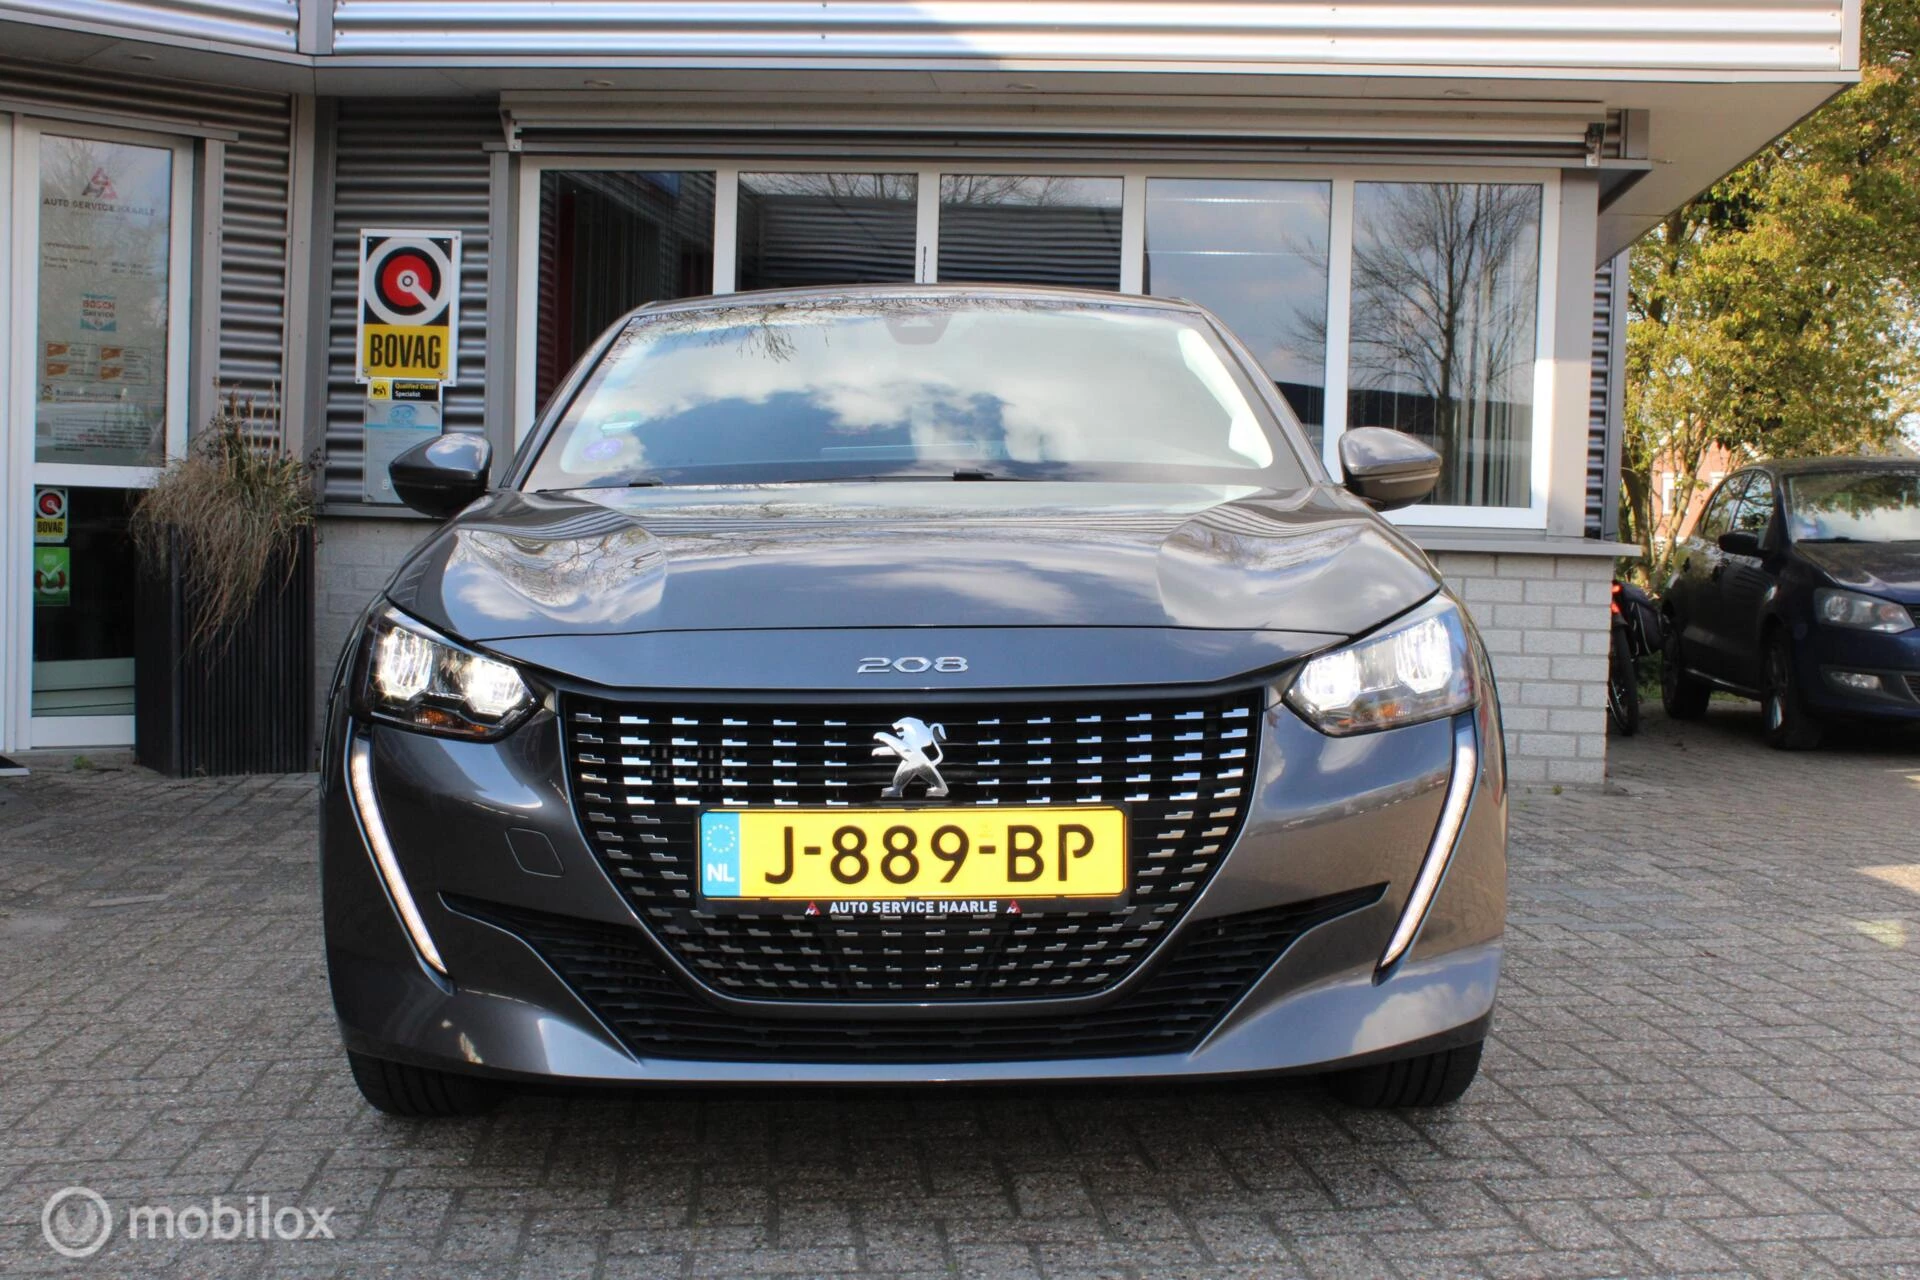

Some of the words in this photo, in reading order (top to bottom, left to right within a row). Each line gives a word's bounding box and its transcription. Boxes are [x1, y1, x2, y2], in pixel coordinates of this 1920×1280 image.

[43, 197, 69, 207] AUTO
[82, 299, 115, 310] BOSCH
[82, 309, 115, 318] Service
[370, 333, 441, 369] BOVAG
[394, 390, 421, 399] Specialist
[36, 520, 64, 534] BOVAG
[857, 656, 968, 673] 208
[765, 824, 1095, 885] J-889-BP
[706, 863, 736, 883] NL
[829, 901, 869, 914] AUTO
[872, 900, 936, 914] SERVICE
[938, 899, 998, 914] HAARLE
